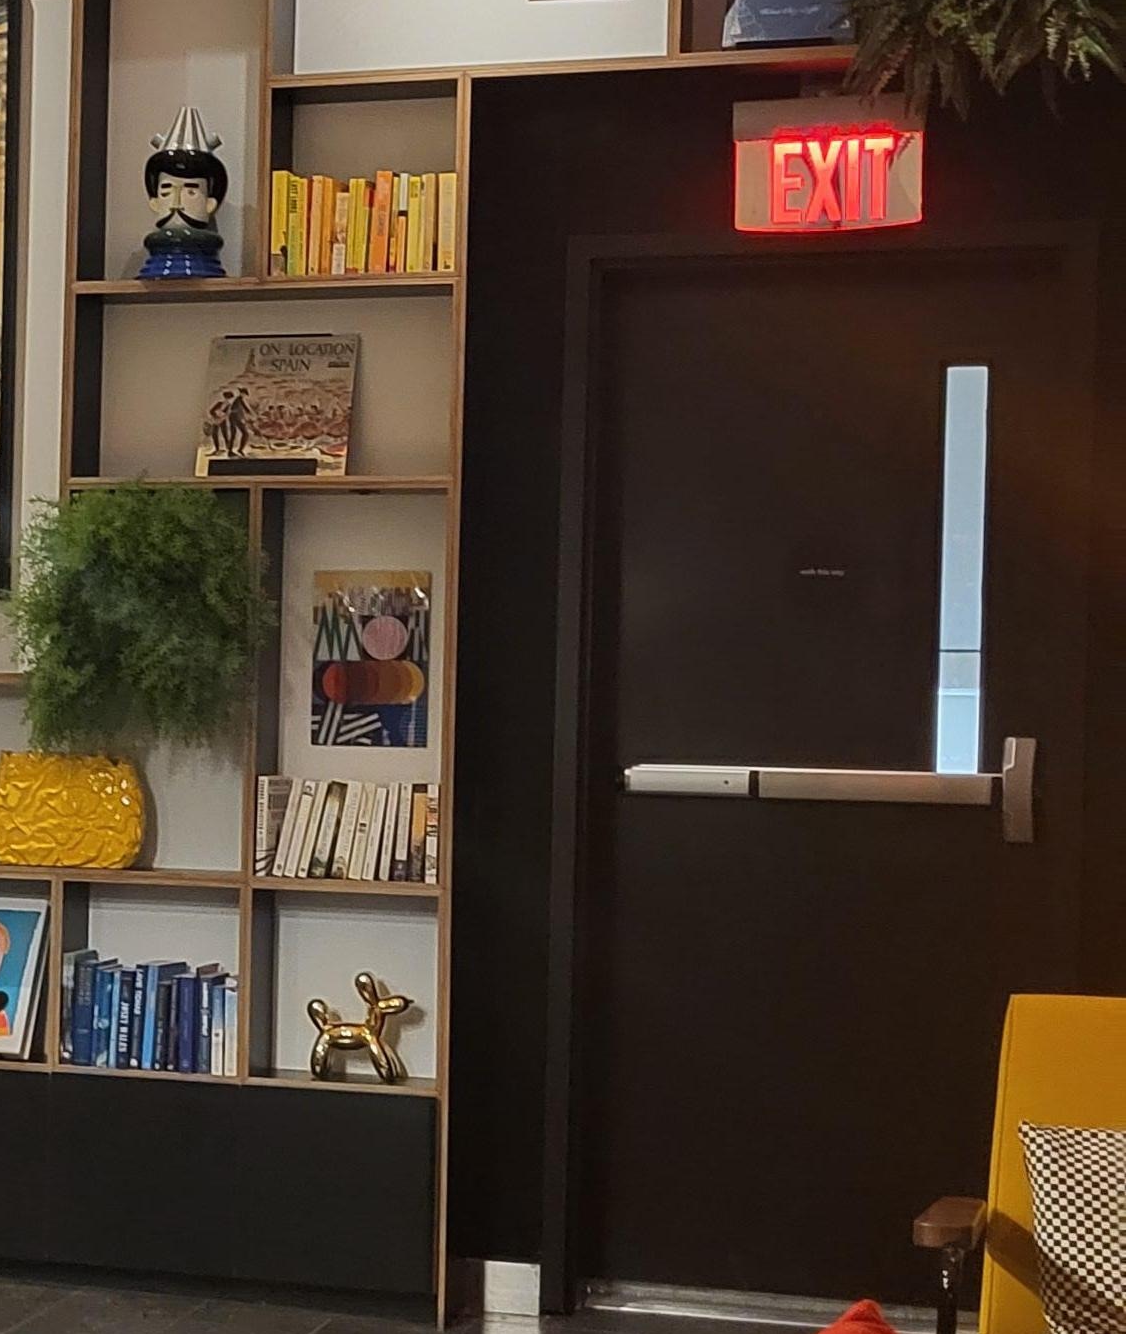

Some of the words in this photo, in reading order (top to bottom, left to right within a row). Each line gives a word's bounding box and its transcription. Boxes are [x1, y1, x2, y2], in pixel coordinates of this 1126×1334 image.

[771, 137, 895, 224] EXIT
[259, 342, 281, 356] ON
[289, 341, 355, 356] LOCATION
[270, 358, 312, 372] SPAIN
